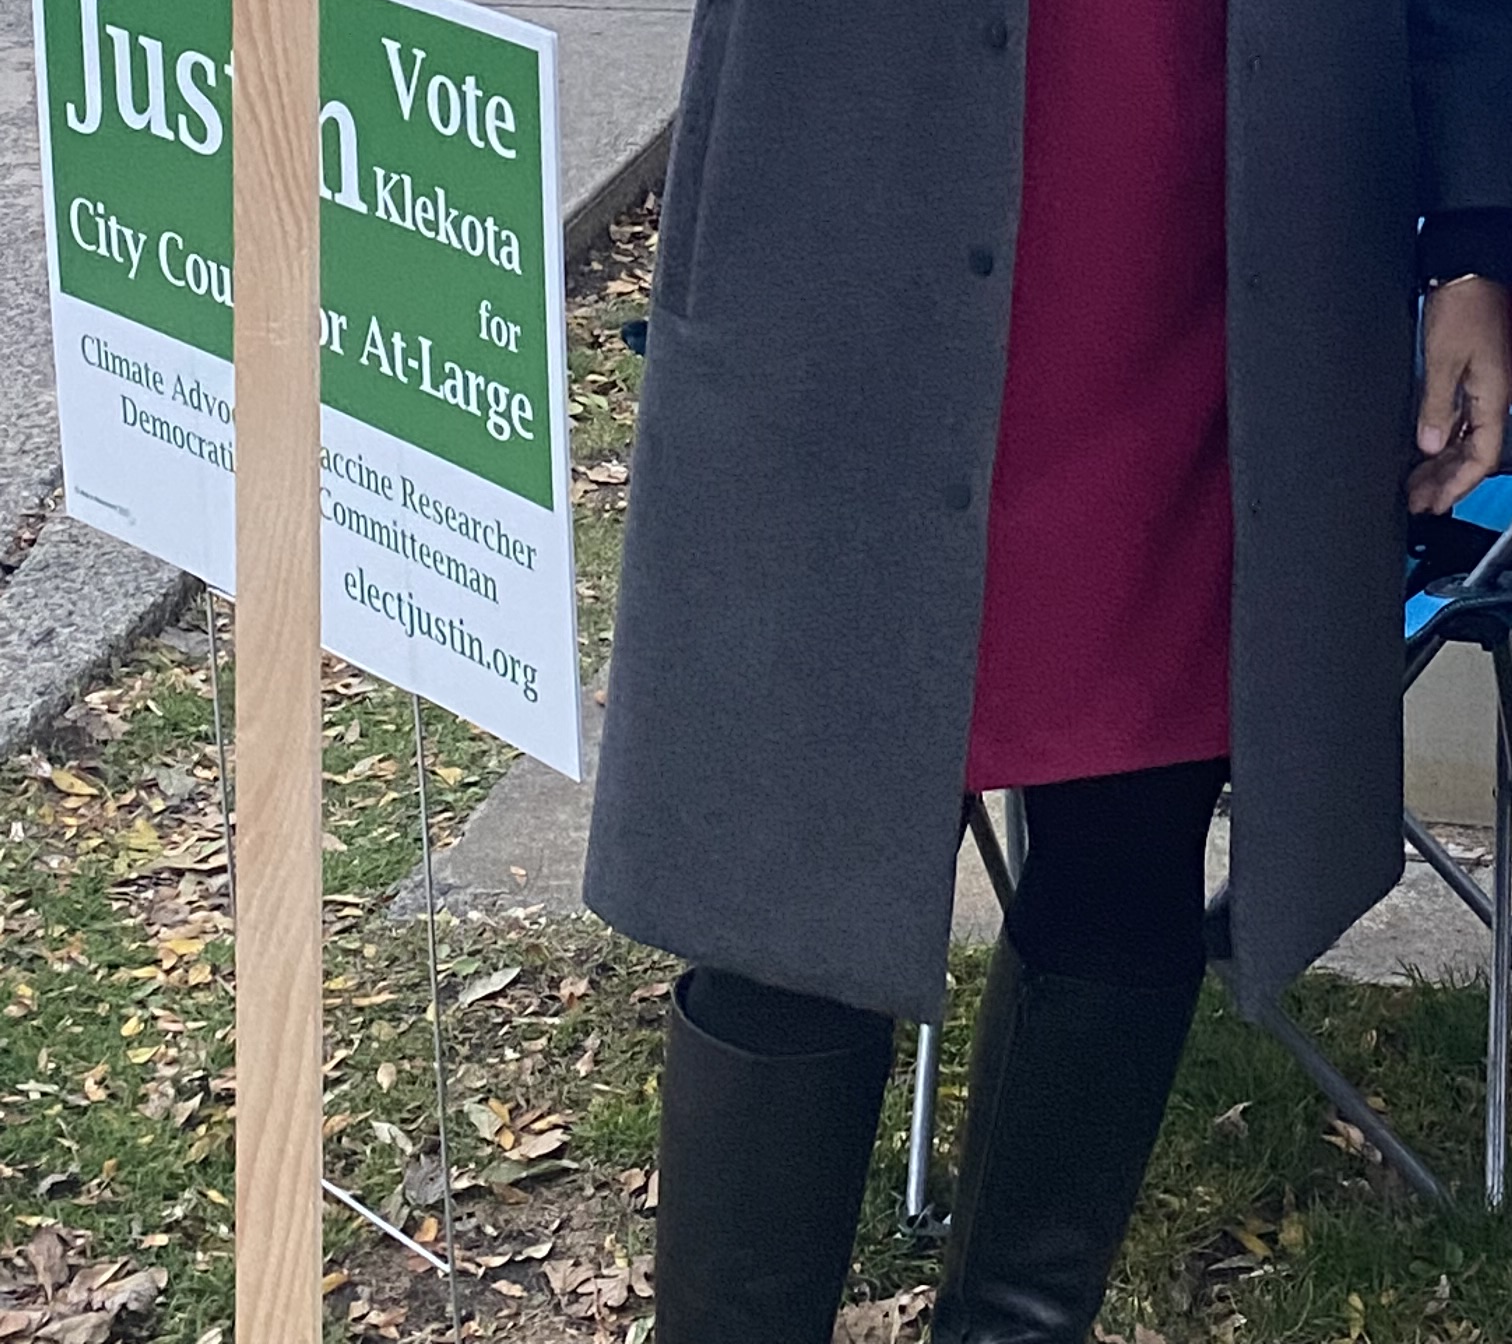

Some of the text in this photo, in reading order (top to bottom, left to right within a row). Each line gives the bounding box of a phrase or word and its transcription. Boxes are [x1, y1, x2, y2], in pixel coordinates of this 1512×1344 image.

[381, 38, 517, 158] Vote
[373, 166, 522, 275] Klekota
[69, 198, 146, 279] City
[360, 315, 535, 441] At-Large
[479, 300, 521, 353] for
[81, 334, 164, 395] Climate
[320, 447, 393, 500] accine
[400, 475, 538, 571] Researcher
[120, 395, 499, 605] Democrati Committeeman
[344, 566, 539, 703] electjustin.org
